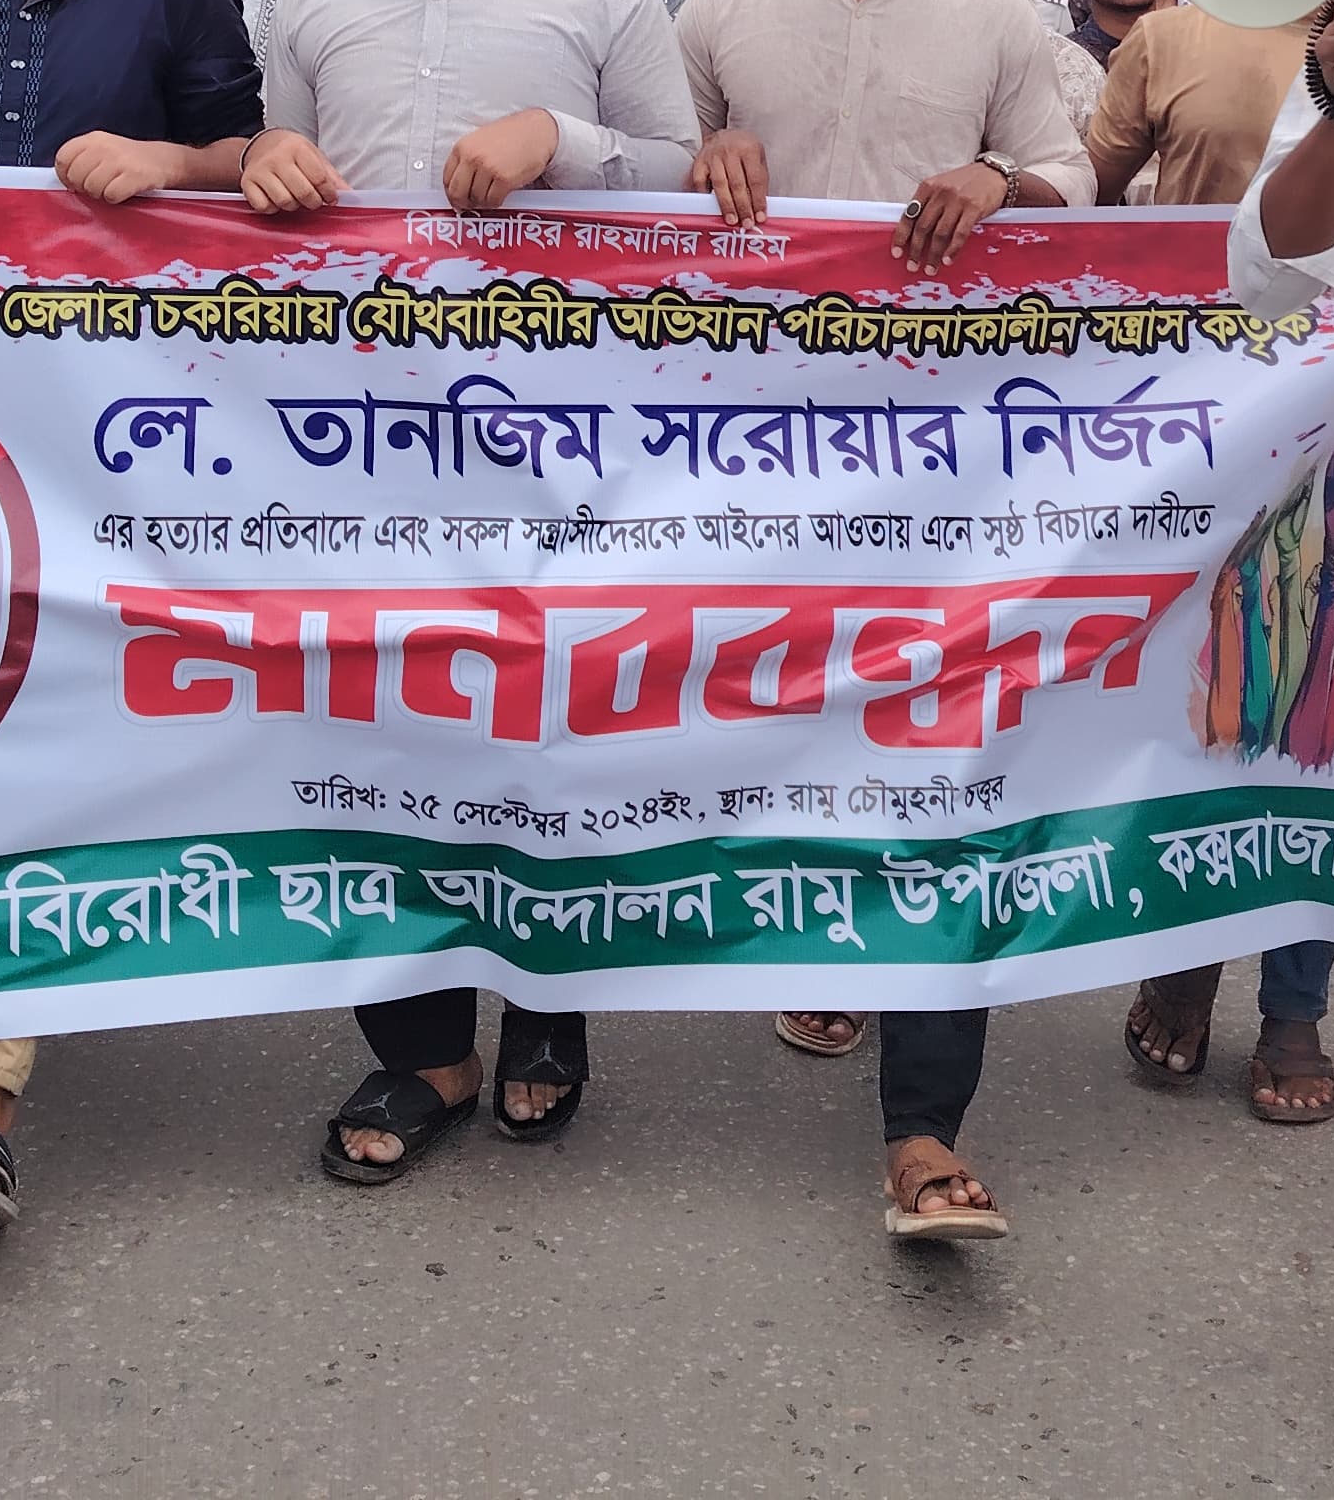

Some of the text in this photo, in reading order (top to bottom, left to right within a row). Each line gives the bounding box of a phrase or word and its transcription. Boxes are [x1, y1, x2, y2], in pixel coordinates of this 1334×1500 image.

[572, 219, 703, 256] রাহমানির
[708, 225, 791, 262] রাহিম
[2, 287, 142, 335] জেলার
[150, 279, 341, 338] চকরিয়ায়
[352, 280, 598, 344] যৌথবাহিনীর
[608, 291, 770, 349] অভিযান
[781, 296, 1084, 352] পরিচালনাকালীন
[1091, 306, 1191, 351] সন্ত্রাস
[93, 373, 1224, 480] লে. তানজিম সরোয়ার নির্জন
[93, 512, 136, 553] এর
[142, 511, 234, 556] হত্যার
[240, 501, 367, 556] প্রতিবাদে
[373, 514, 433, 557] এবং
[439, 514, 515, 552] সকল
[691, 502, 802, 553] আইনের
[807, 509, 915, 553] আওতায়
[920, 513, 976, 555] এনে
[1032, 498, 1123, 547] বিচারে
[1127, 489, 1217, 542] দাবীতে
[104, 570, 1202, 750] মানববন্ধন
[398, 789, 443, 821] ২৫
[452, 796, 572, 838] সেপ্টেম্বর
[783, 781, 840, 823] রামু
[847, 773, 961, 825] চৌমুহনী
[268, 853, 405, 938] ছাত্র
[418, 859, 722, 944] আন্দোলন
[734, 859, 866, 951] রামু
